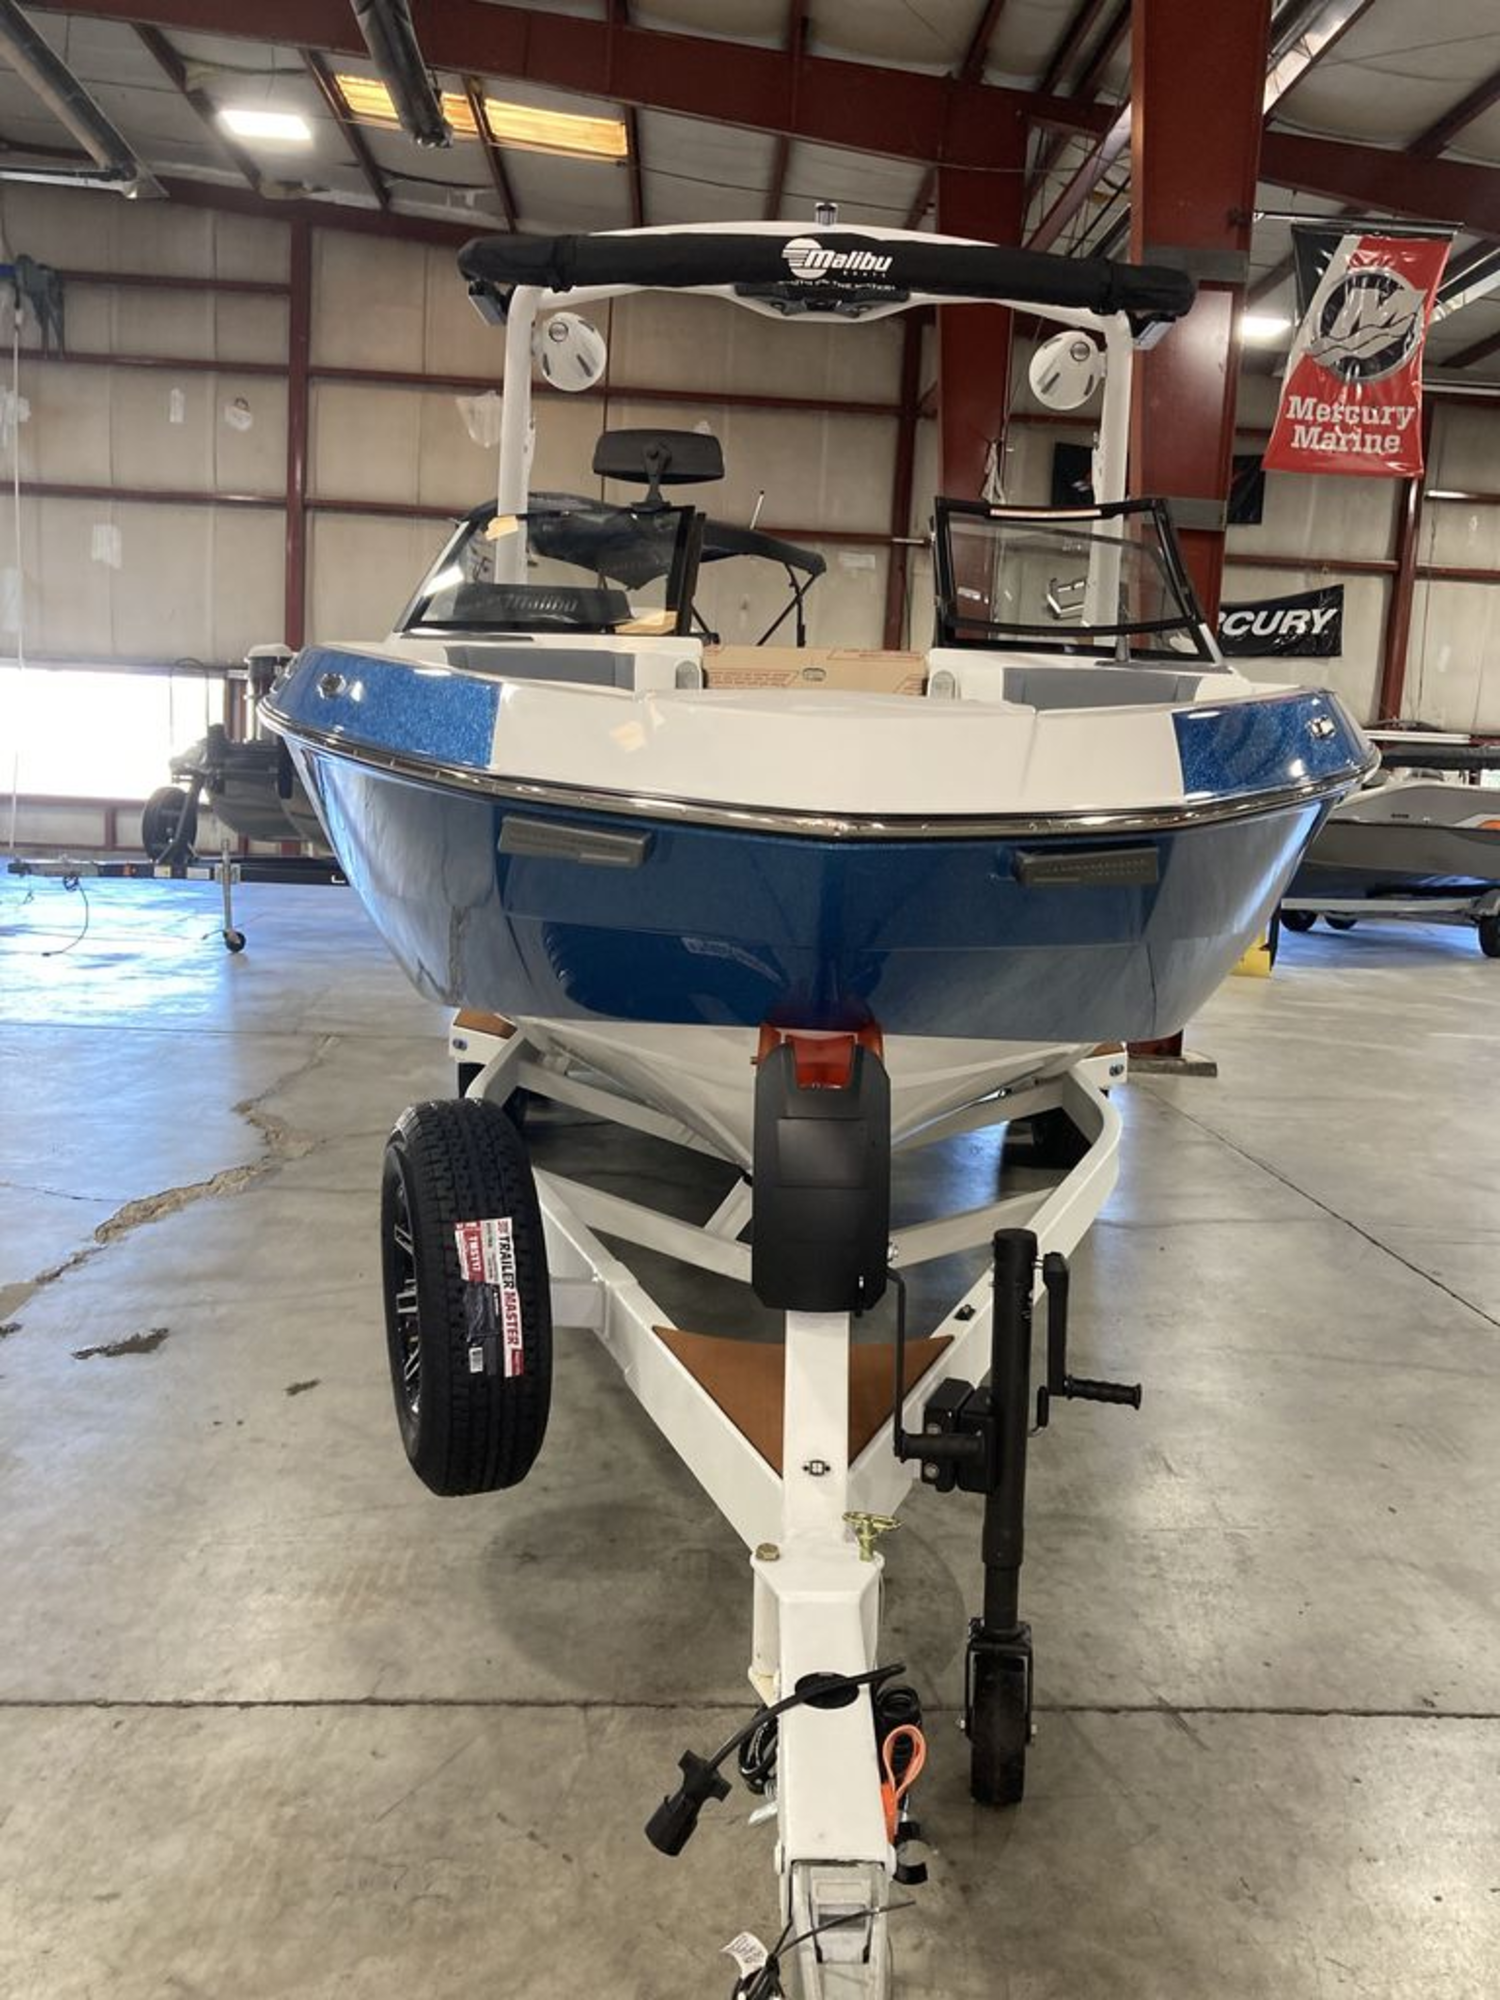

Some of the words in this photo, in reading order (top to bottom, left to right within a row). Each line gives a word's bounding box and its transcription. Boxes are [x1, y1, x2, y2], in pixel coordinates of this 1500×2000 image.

[805, 250, 893, 271] Malibu
[1286, 395, 1416, 430] Mercury
[1291, 424, 1401, 456] Marine
[1218, 608, 1338, 637] CURY
[498, 1236, 515, 1290] TRAILER
[504, 1292, 520, 1345] MASTER
